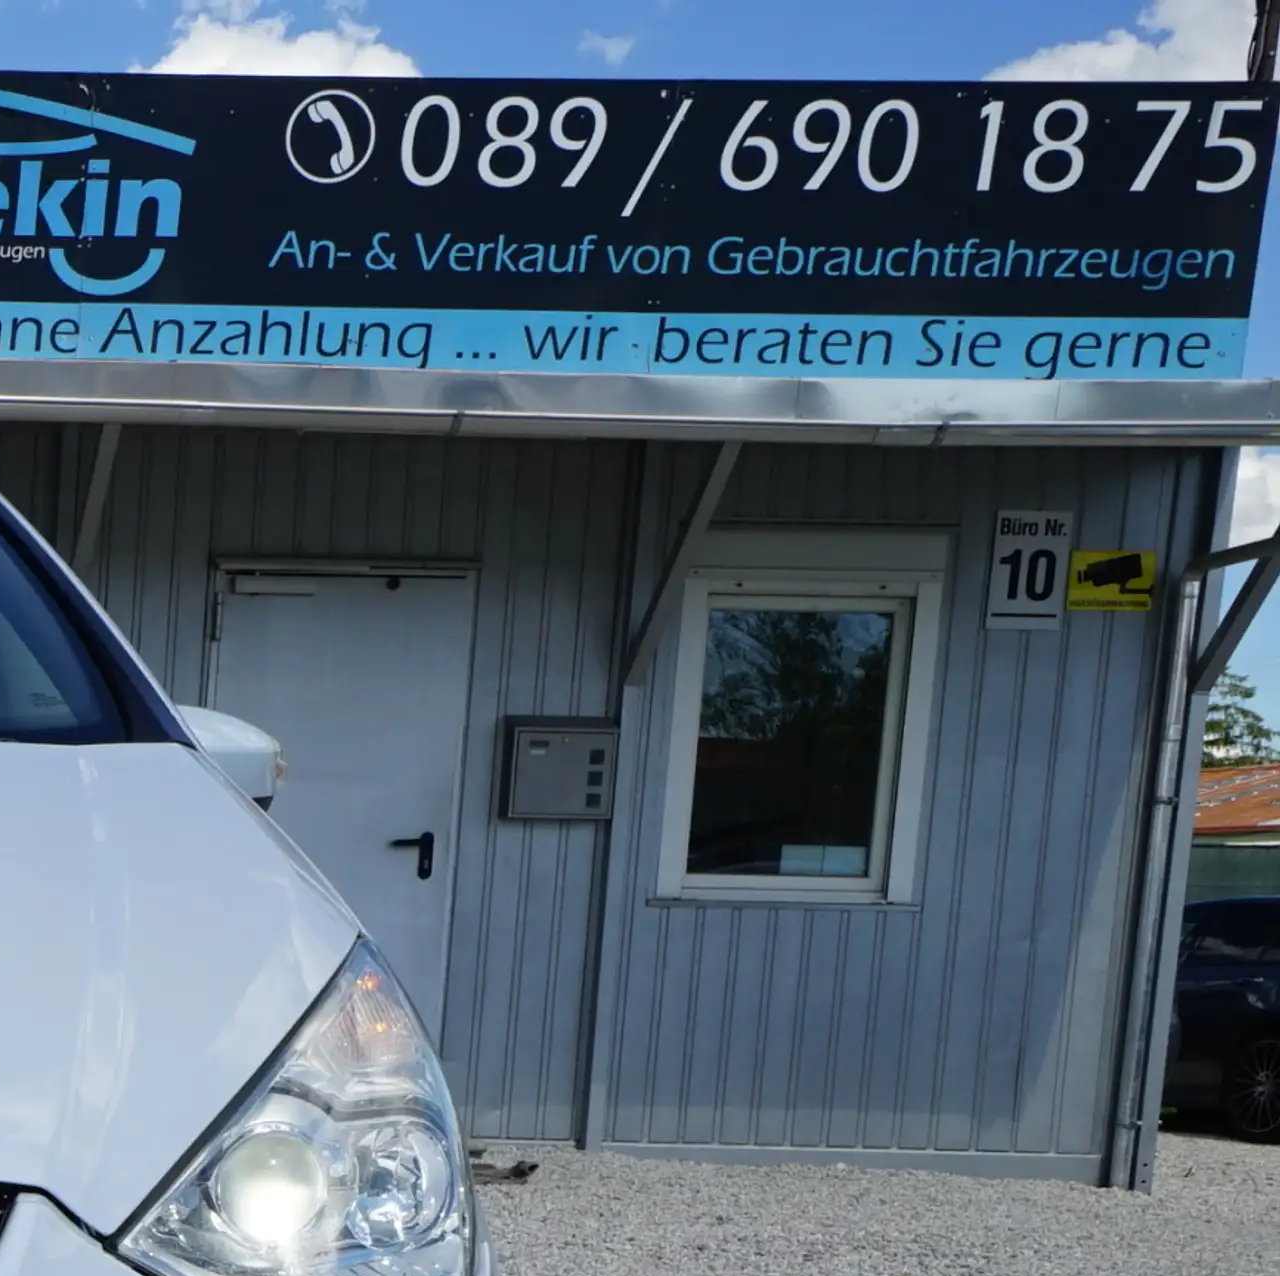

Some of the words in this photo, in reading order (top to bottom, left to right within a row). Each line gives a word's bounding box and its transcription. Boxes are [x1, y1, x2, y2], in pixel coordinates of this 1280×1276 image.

[401, 94, 608, 188] 089
[720, 100, 919, 192] 690
[976, 100, 1089, 193] 18
[1130, 100, 1263, 193] 75
[269, 230, 352, 269] An-
[365, 231, 397, 270] &
[414, 232, 598, 274] Verkauf
[607, 245, 691, 275] von
[707, 236, 1235, 290] Gebrauchtfahrzeugen
[98, 307, 433, 369] Anzahlung
[523, 315, 619, 362] wir
[653, 315, 893, 367] beraten
[915, 318, 1002, 368] Sie
[1024, 331, 1211, 380] gerne
[999, 517, 1039, 537] Büro
[1044, 518, 1068, 537] Nr.
[998, 548, 1057, 602] 10
